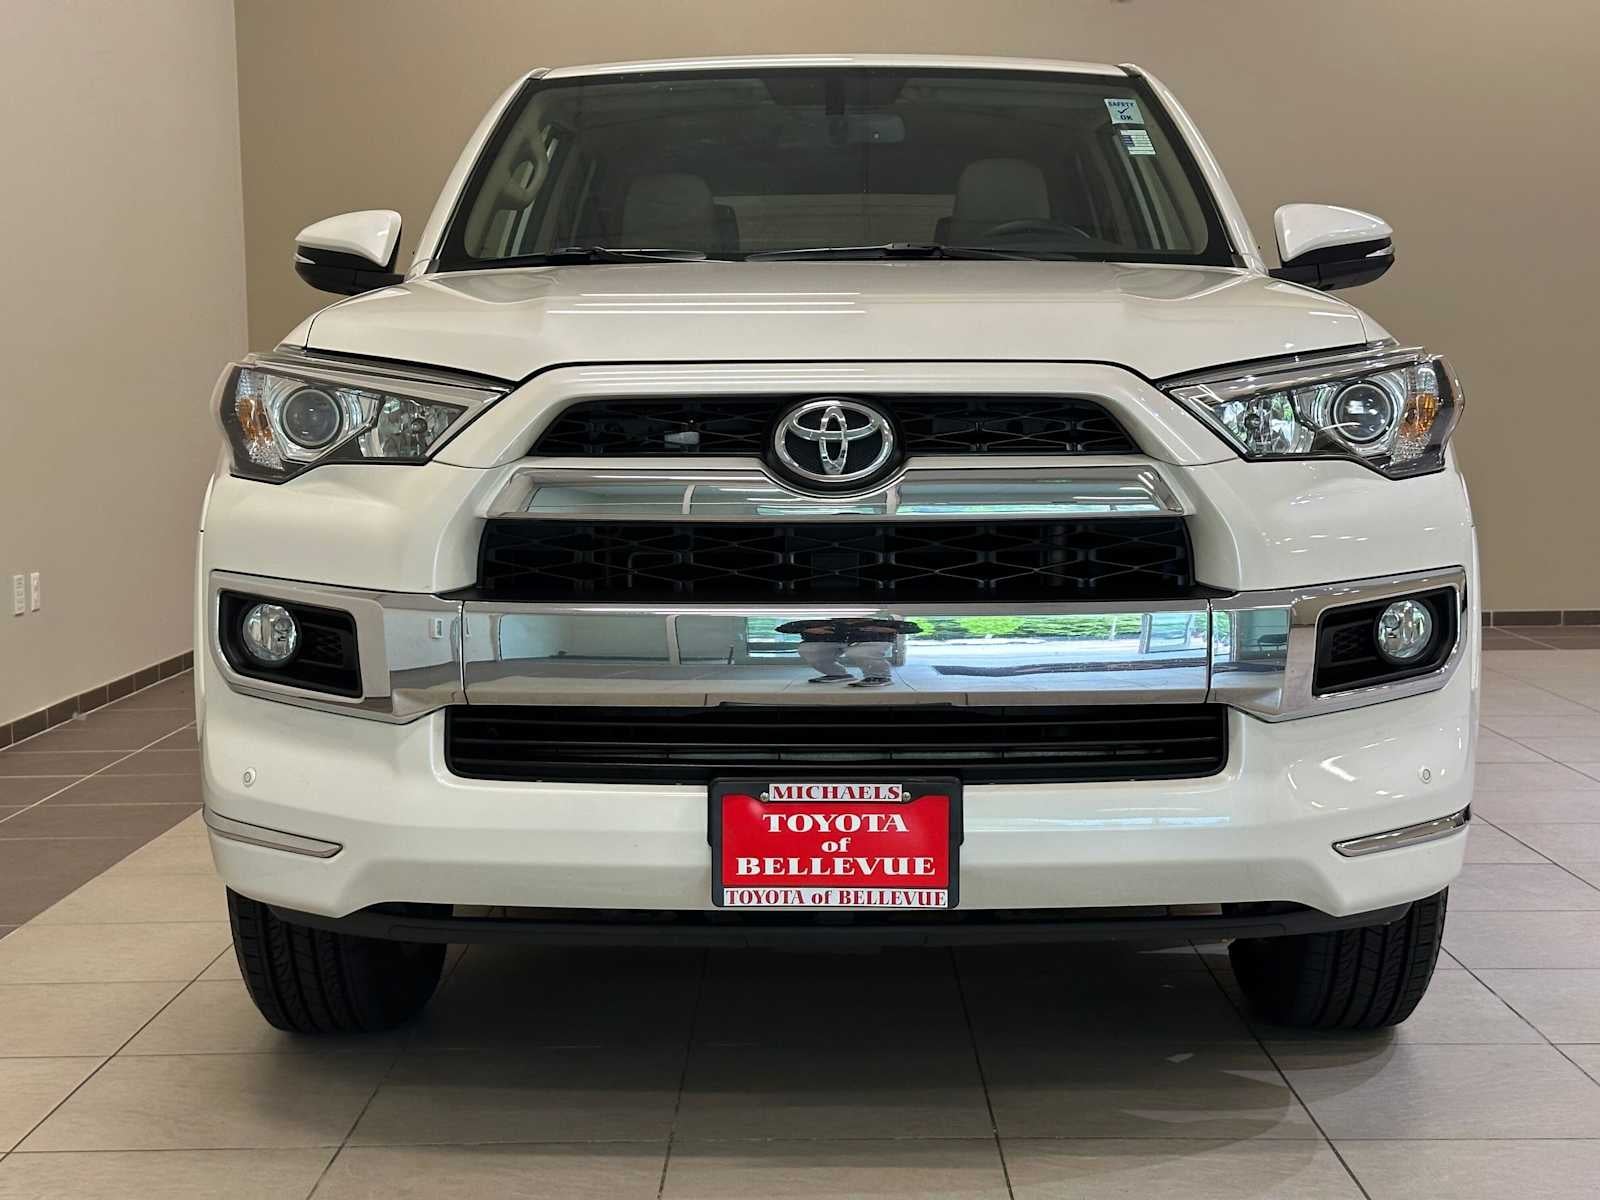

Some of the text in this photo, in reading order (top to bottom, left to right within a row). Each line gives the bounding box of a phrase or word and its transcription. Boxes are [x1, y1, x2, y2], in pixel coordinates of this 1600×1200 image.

[772, 786, 900, 800] MICHAELS
[763, 813, 909, 833] TOYOTA
[821, 837, 852, 853] of
[736, 857, 936, 876] BELLEVUE
[725, 889, 947, 906] TOYOTA of BELLEVUE
